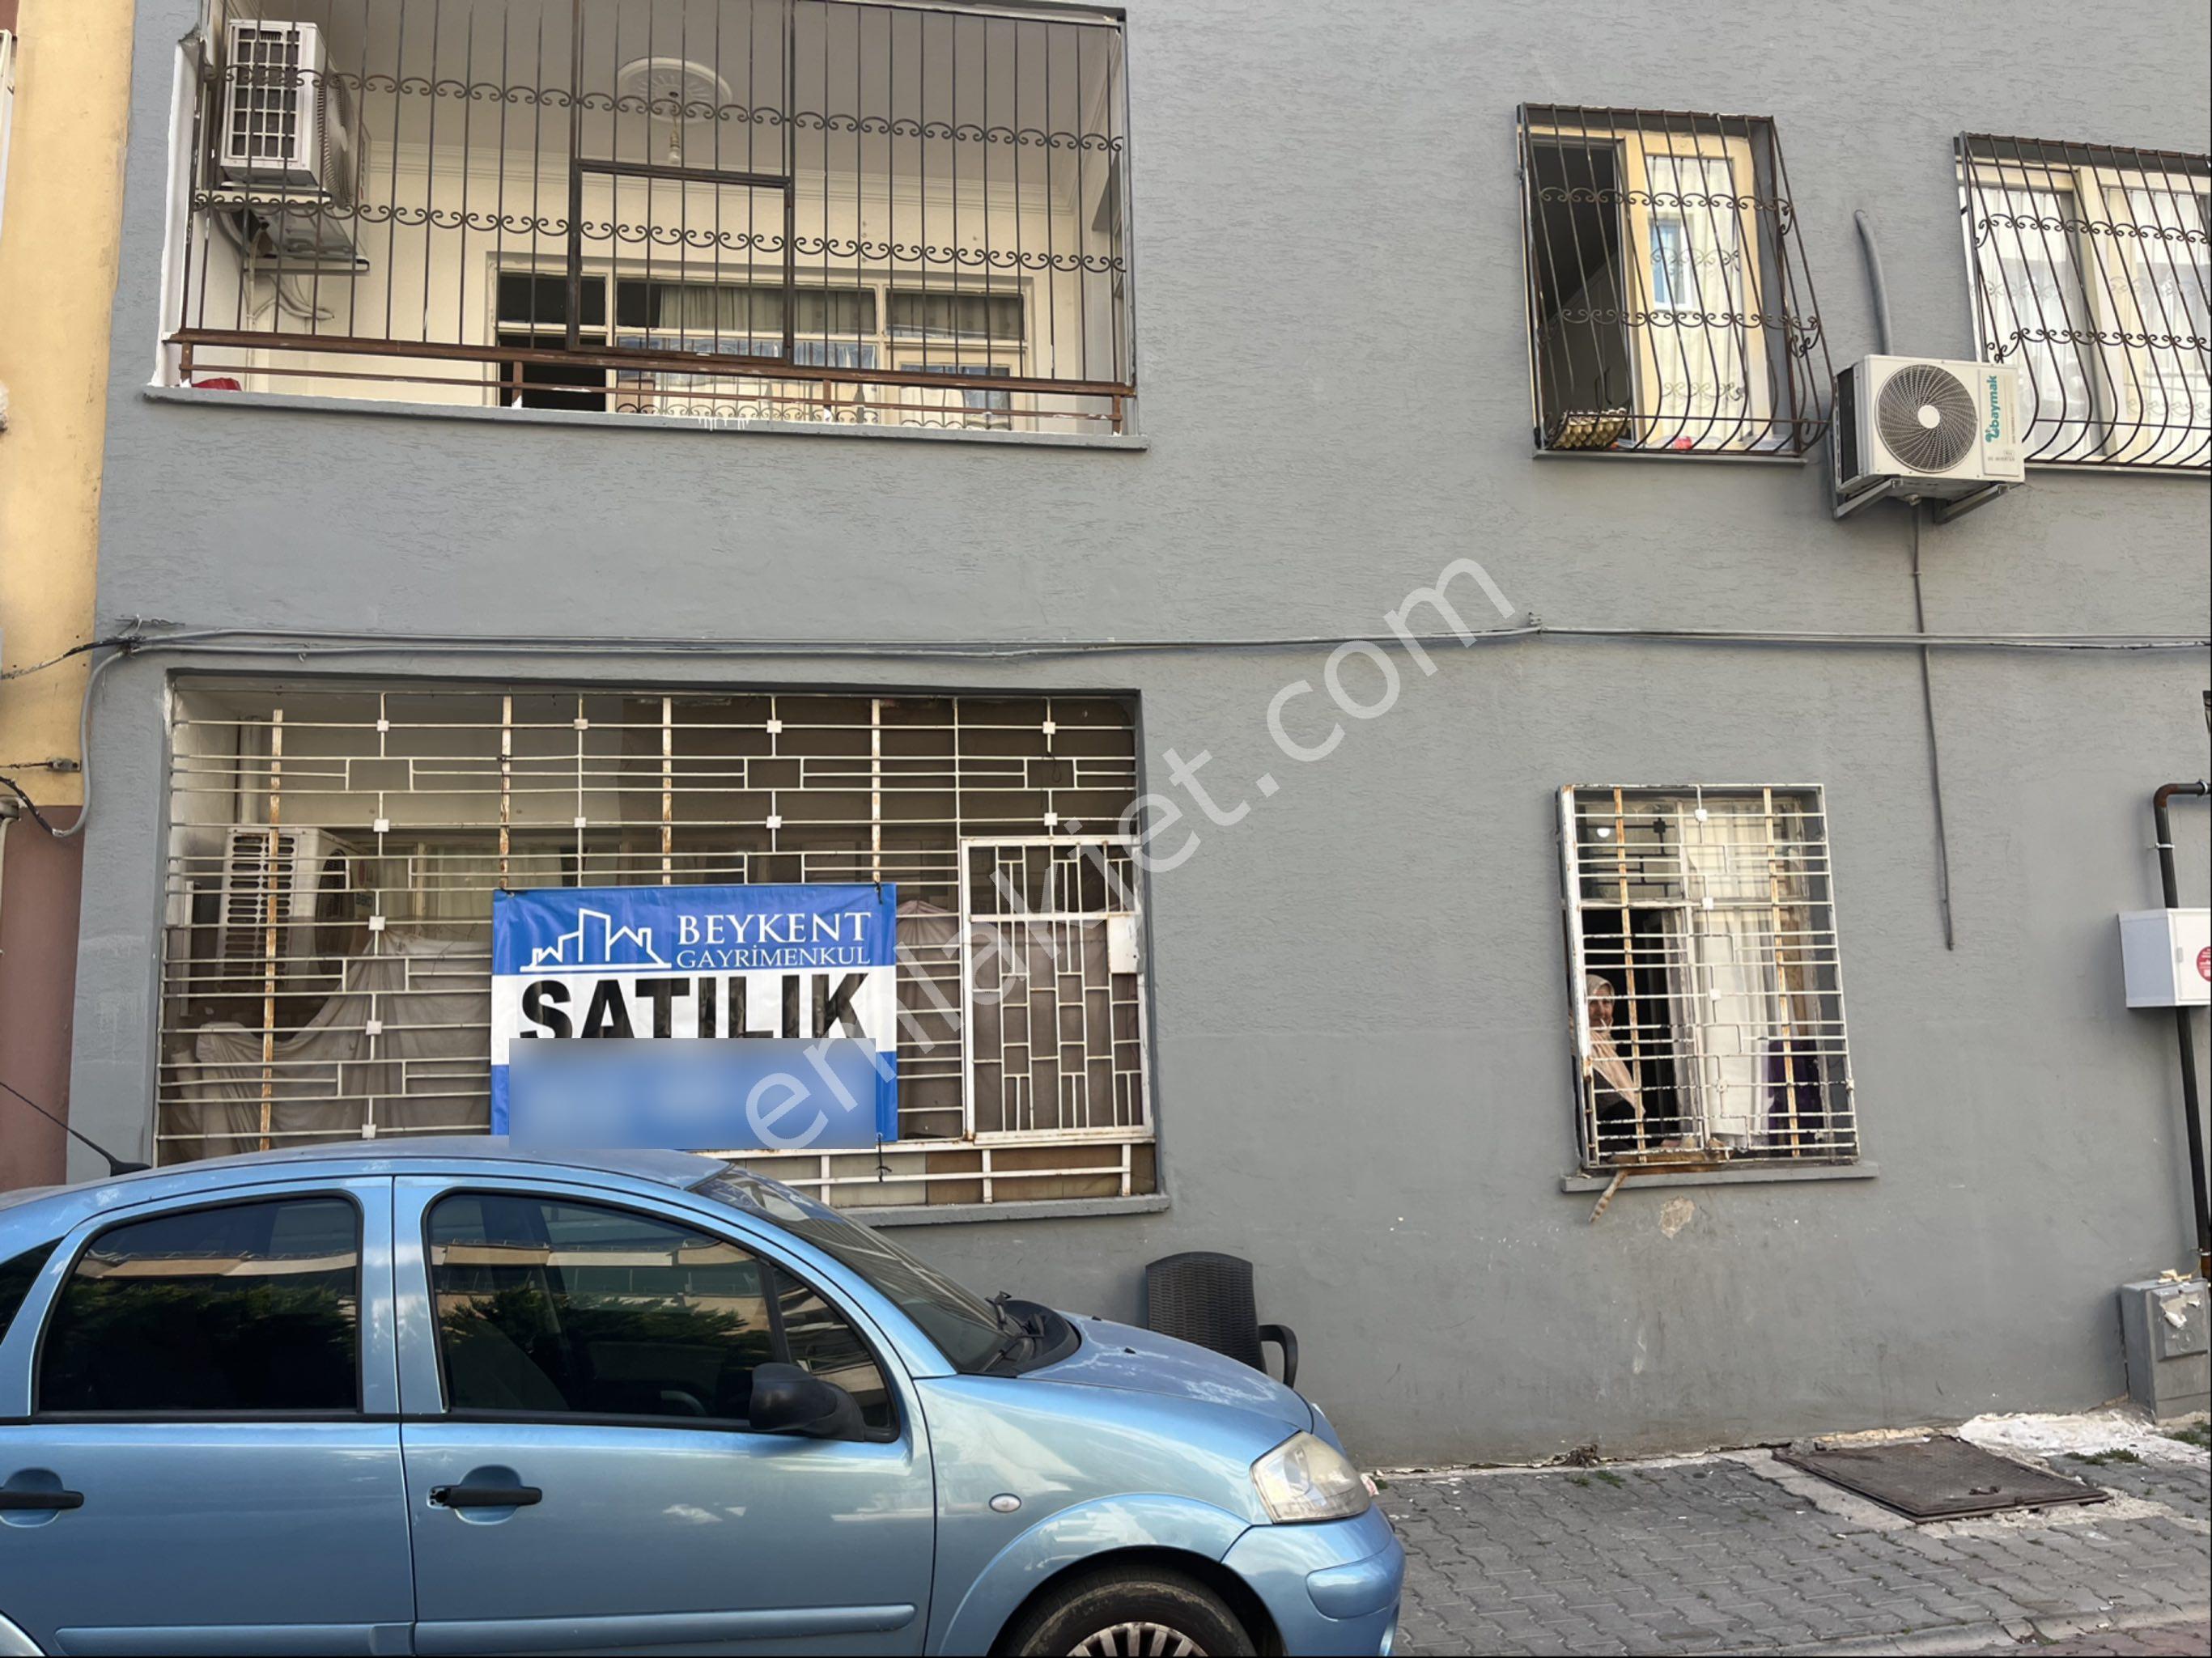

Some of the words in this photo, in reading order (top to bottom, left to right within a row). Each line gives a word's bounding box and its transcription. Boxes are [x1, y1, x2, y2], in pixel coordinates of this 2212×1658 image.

[1987, 375, 2001, 429] baymak
[677, 912, 872, 945] BEYKENT
[676, 944, 871, 969] GAYRİMENKUL
[520, 973, 869, 1038] SATILIK
